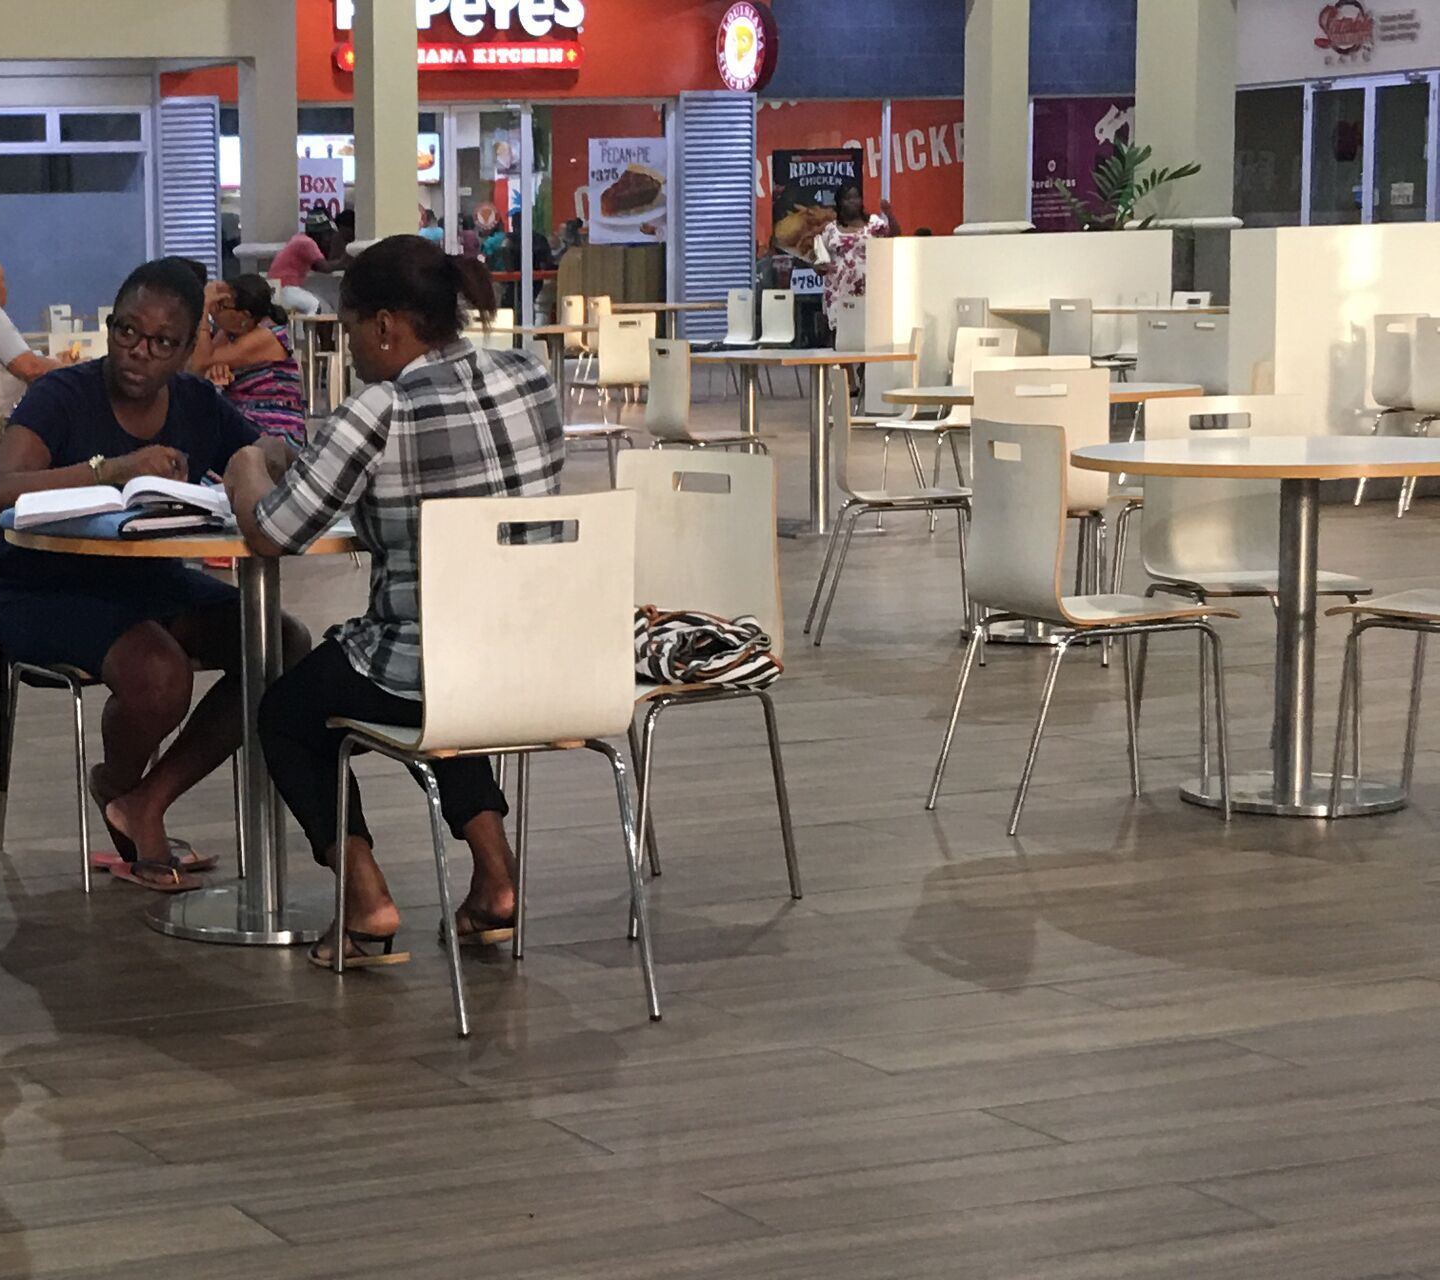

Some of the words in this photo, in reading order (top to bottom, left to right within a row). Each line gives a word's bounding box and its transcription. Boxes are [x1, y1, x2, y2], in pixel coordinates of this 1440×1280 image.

[723, 5, 764, 51] LOUISIANA
[473, 48, 563, 64] KITCHEN
[720, 52, 757, 89] KITCHEN
[799, 176, 843, 187] CHICKEN
